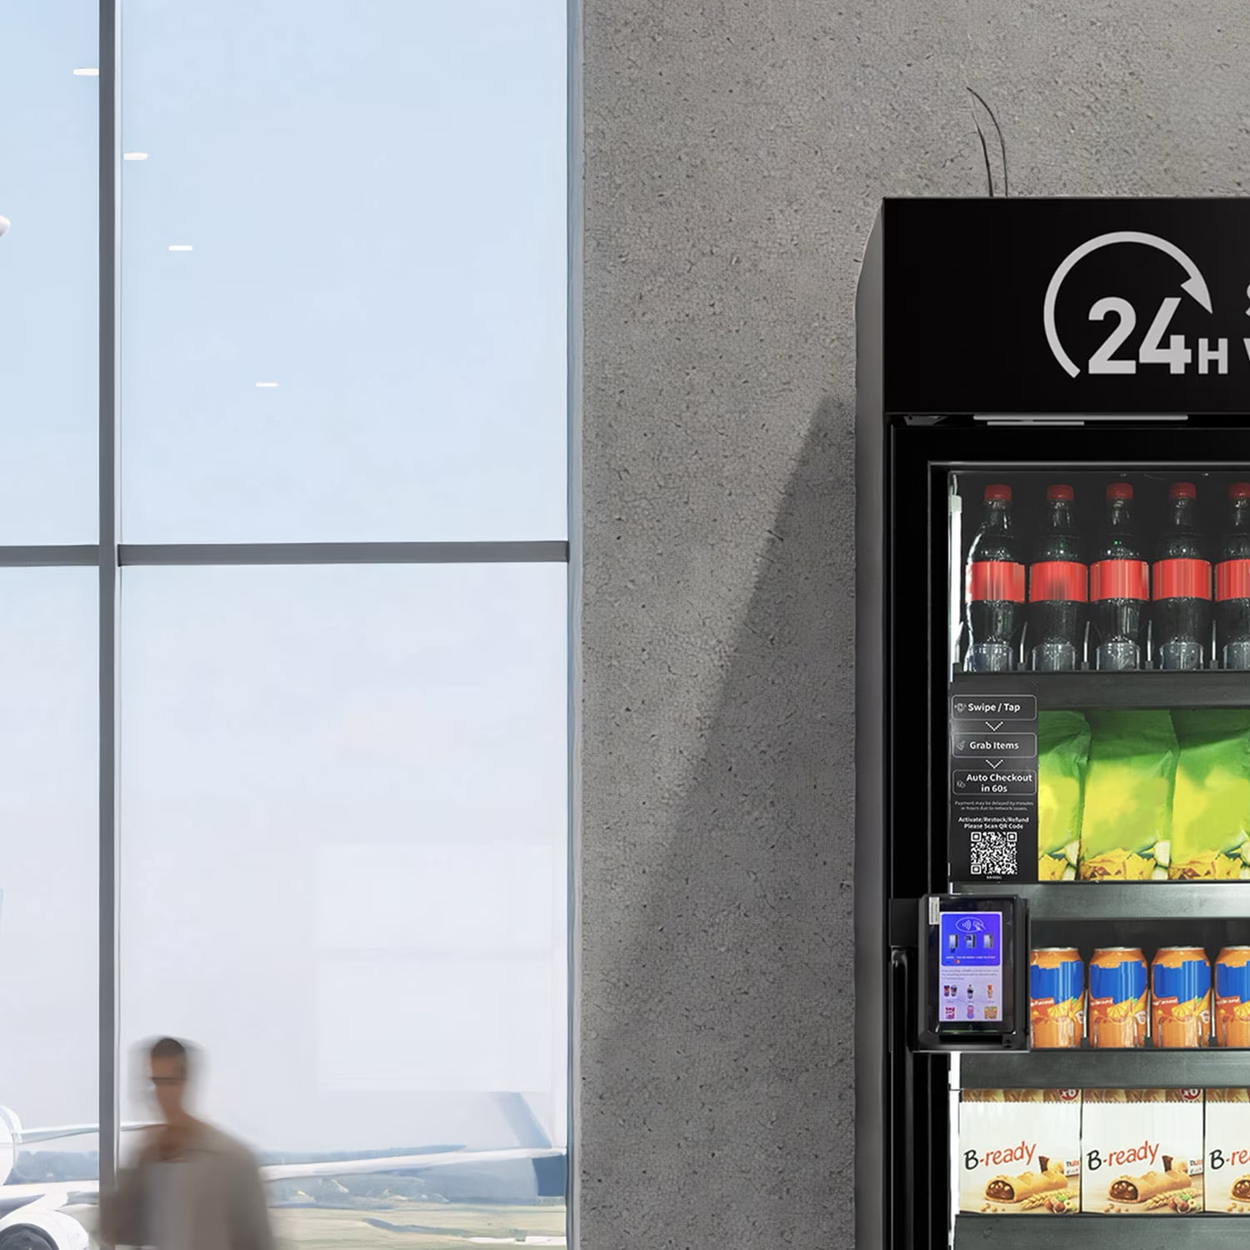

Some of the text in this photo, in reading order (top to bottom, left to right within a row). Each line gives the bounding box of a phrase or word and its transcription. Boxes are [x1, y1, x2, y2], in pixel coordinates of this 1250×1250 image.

[1088, 297, 1229, 375] 24H
[967, 703, 1021, 713] Swipe / Tap
[969, 741, 1019, 750] Grab Items
[966, 773, 1033, 782] Auto Checkout
[981, 784, 990, 792] in
[964, 1141, 1037, 1170] B-ready
[1087, 1140, 1160, 1171] B-ready
